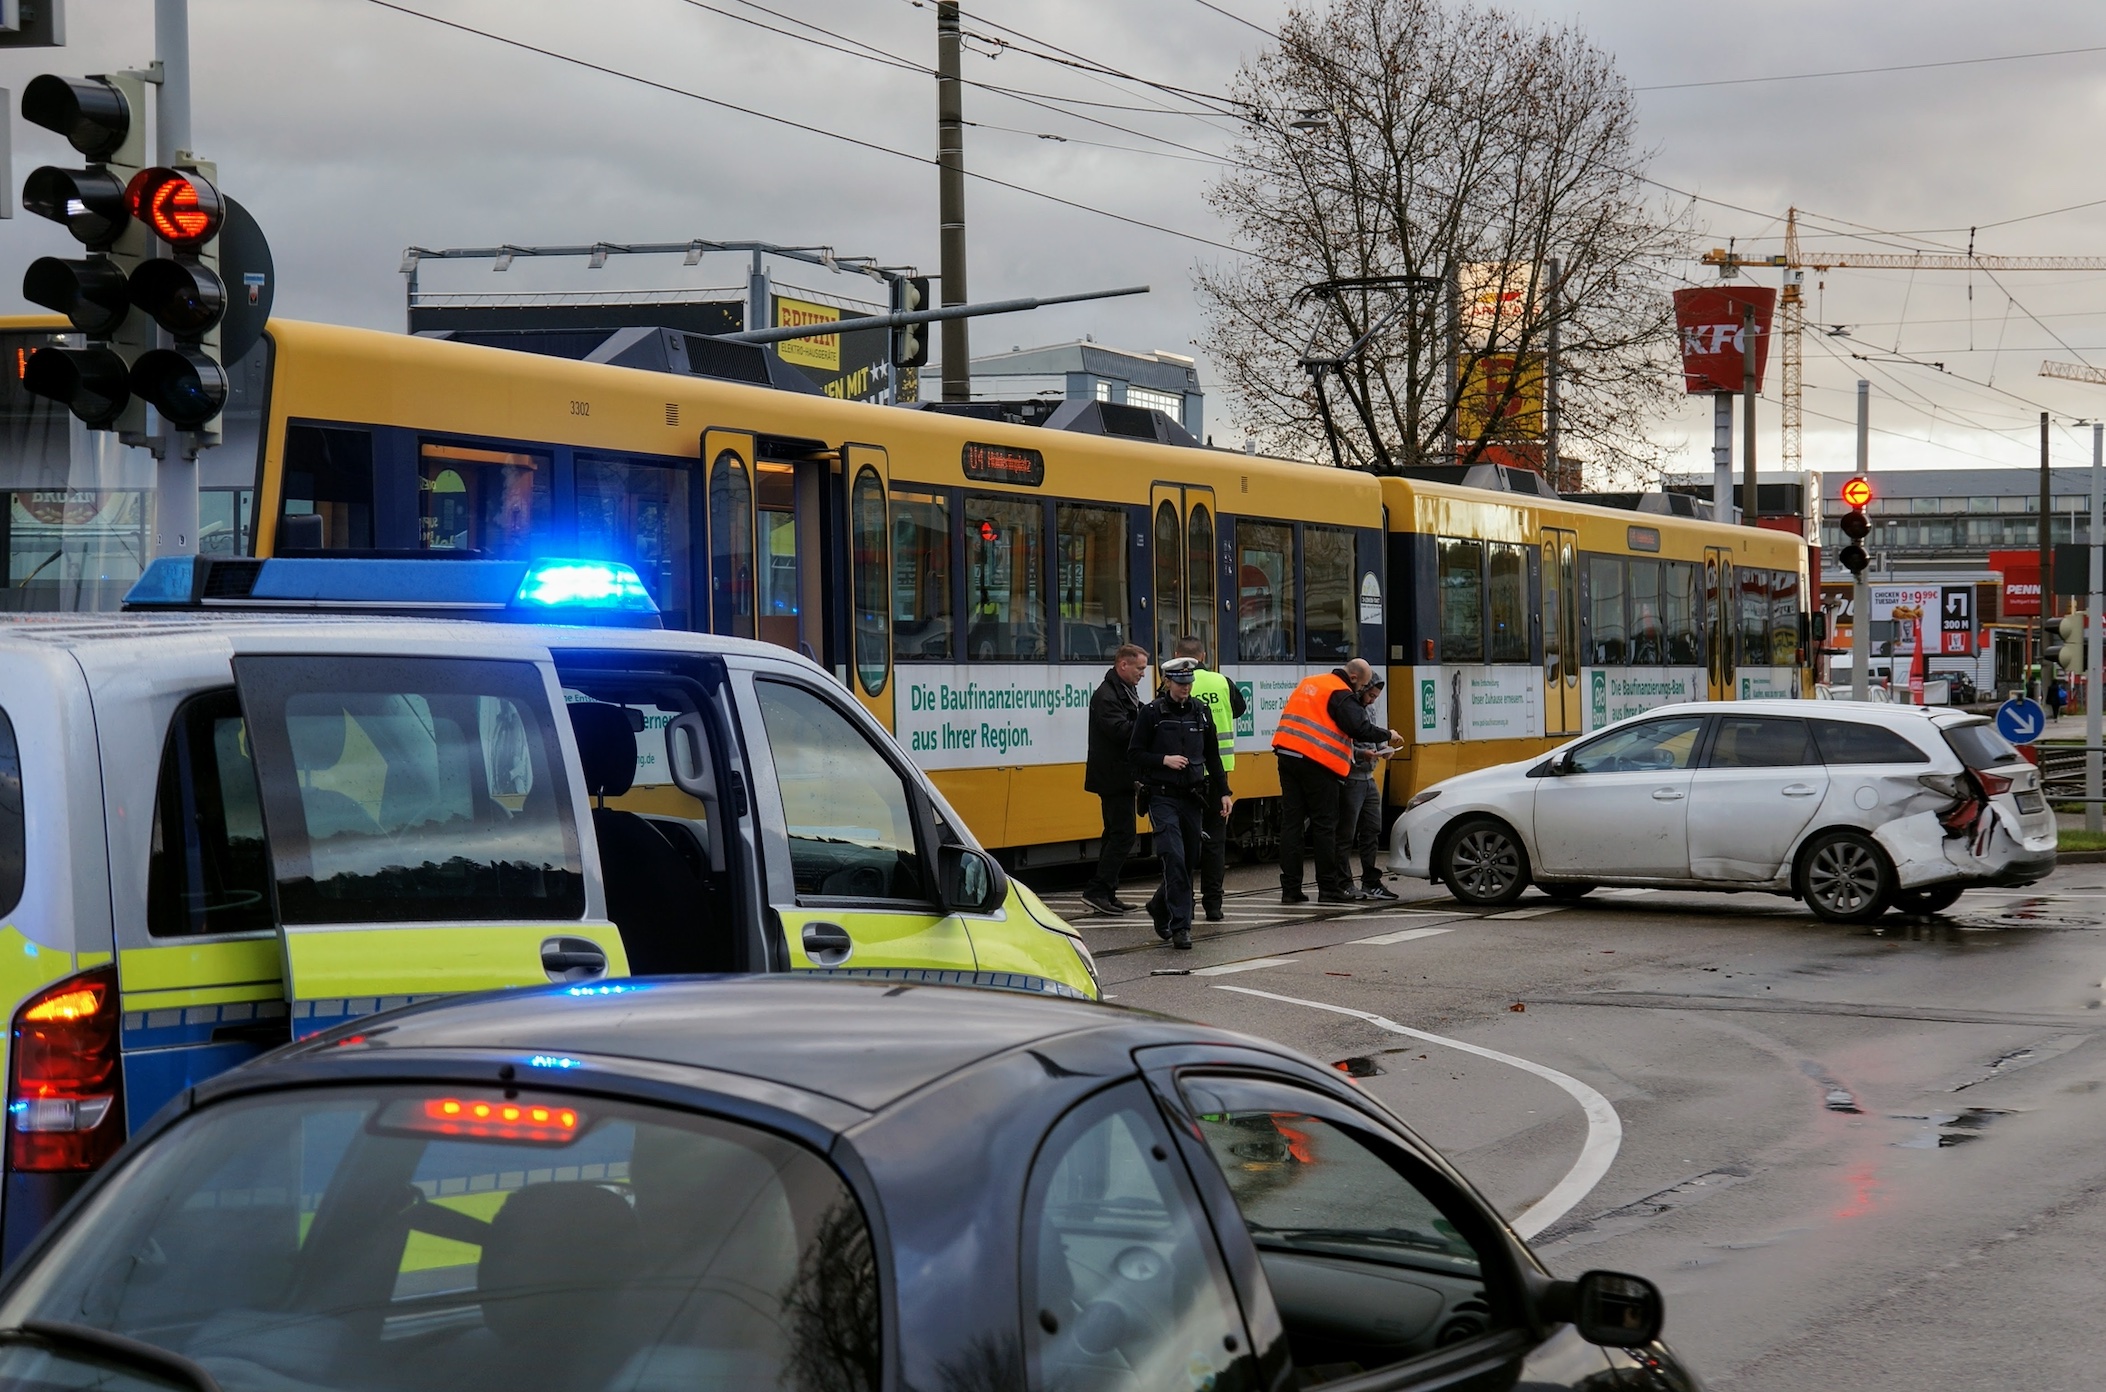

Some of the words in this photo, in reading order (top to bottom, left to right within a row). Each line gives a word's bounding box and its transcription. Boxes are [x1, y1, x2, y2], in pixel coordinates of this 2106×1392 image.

[846, 366, 869, 399] MIT
[570, 400, 590, 416] 3302
[968, 446, 984, 470] U4
[1901, 591, 1908, 602] 9
[1943, 620, 1961, 629] 300
[1961, 620, 1969, 629] M
[1611, 679, 1622, 696] Die
[1622, 678, 1685, 699] Baufinanzierungs-Bank
[911, 684, 936, 711] Die
[1260, 697, 1278, 711] Unser
[1611, 708, 1622, 720] aus
[1237, 717, 1253, 732] Bank
[912, 730, 937, 751] aus
[942, 722, 977, 750] Ihrer
[981, 721, 1033, 754] Region.
